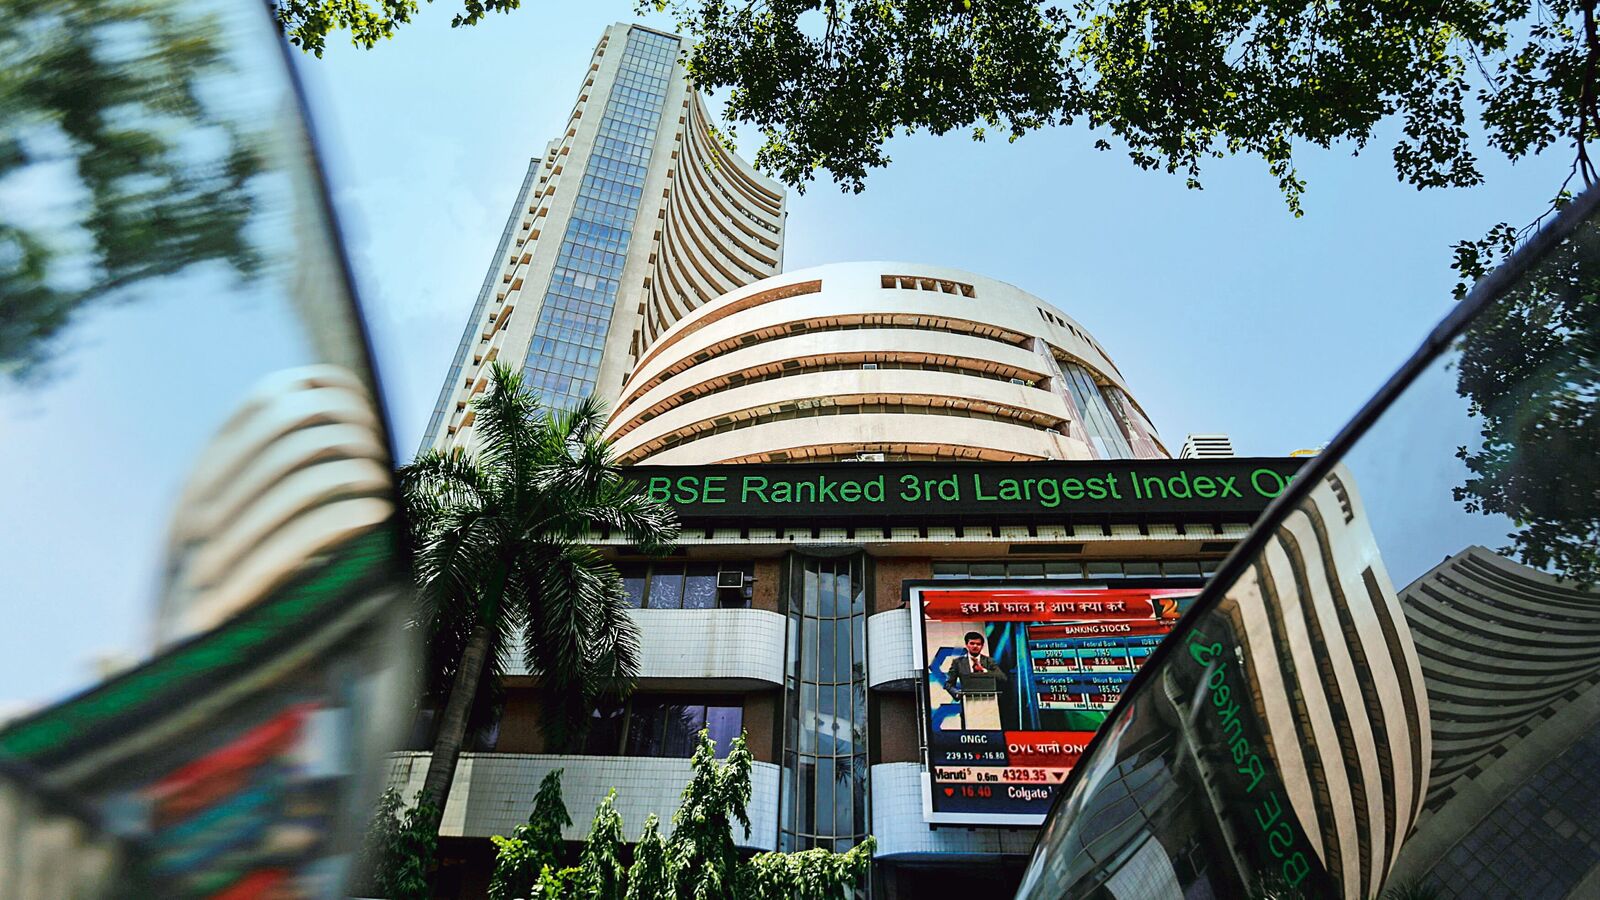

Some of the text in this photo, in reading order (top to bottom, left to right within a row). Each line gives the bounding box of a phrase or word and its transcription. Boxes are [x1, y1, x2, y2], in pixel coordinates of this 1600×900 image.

[647, 475, 727, 505] BSE
[741, 475, 885, 504] Ranked
[899, 474, 961, 502] 3rd
[974, 473, 1121, 508] Largest
[1130, 471, 1243, 499] Index
[960, 602, 979, 614] इस
[1050, 601, 1075, 612] आप
[1078, 601, 1102, 612] क्या
[1065, 624, 1131, 635] BANKING STOCKS
[960, 735, 988, 744] ONGC
[1009, 743, 1034, 753] OVL
[946, 752, 974, 760] 239.15
[977, 773, 998, 782] 0.6m
[1002, 769, 1047, 781] 4329.35
[961, 786, 992, 797] 16.40
